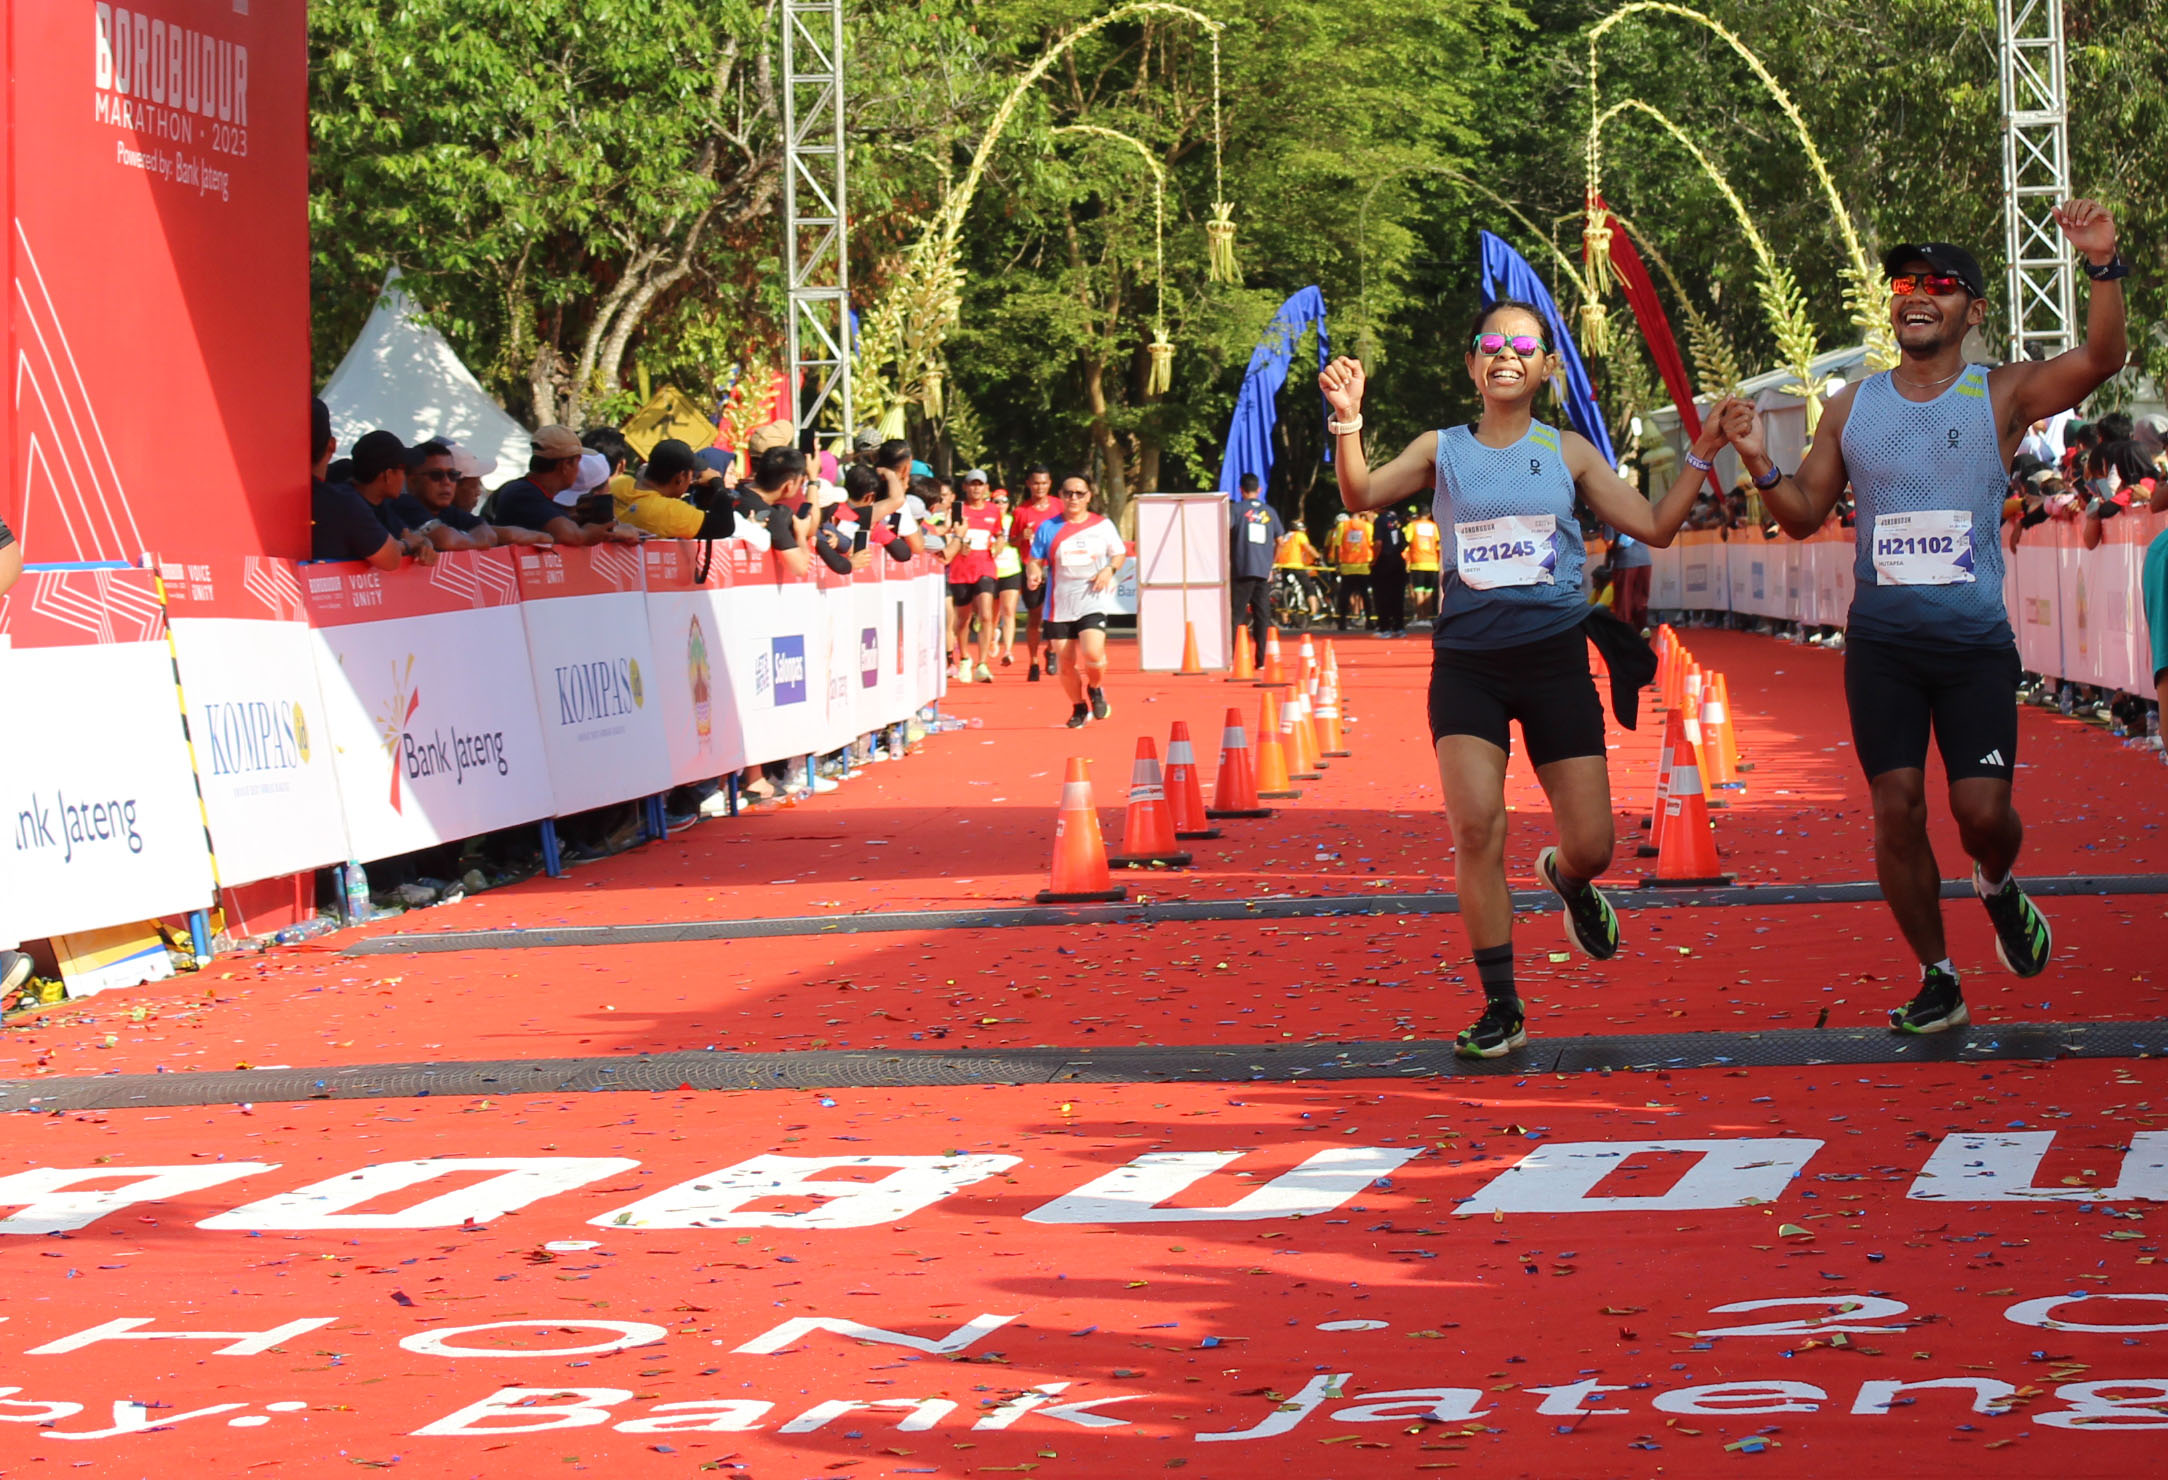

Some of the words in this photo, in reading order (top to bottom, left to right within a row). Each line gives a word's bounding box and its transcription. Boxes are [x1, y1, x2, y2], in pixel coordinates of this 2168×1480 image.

[96, 1, 248, 127] BOROBUDUR
[96, 92, 192, 144] MARATHON
[212, 123, 248, 157] 2023
[117, 140, 157, 171] Powered
[176, 151, 199, 186] Bank
[200, 158, 229, 202] Jateng
[1463, 541, 1536, 564] K21245
[1878, 536, 1954, 556] H21102
[1879, 560, 1905, 568] HUTAPEA
[349, 573, 381, 589] VOICE
[352, 589, 383, 607] UNITY
[555, 657, 633, 726] KOMPAS
[204, 700, 298, 776] KOMPAS
[402, 728, 451, 779] Bank
[451, 726, 508, 785] Jateng
[15, 791, 56, 851] nk
[58, 788, 143, 864] Jateng
[0, 1314, 1021, 1357] HON
[409, 1382, 1150, 1436] Bank
[1195, 1373, 2168, 1442] Jateng
